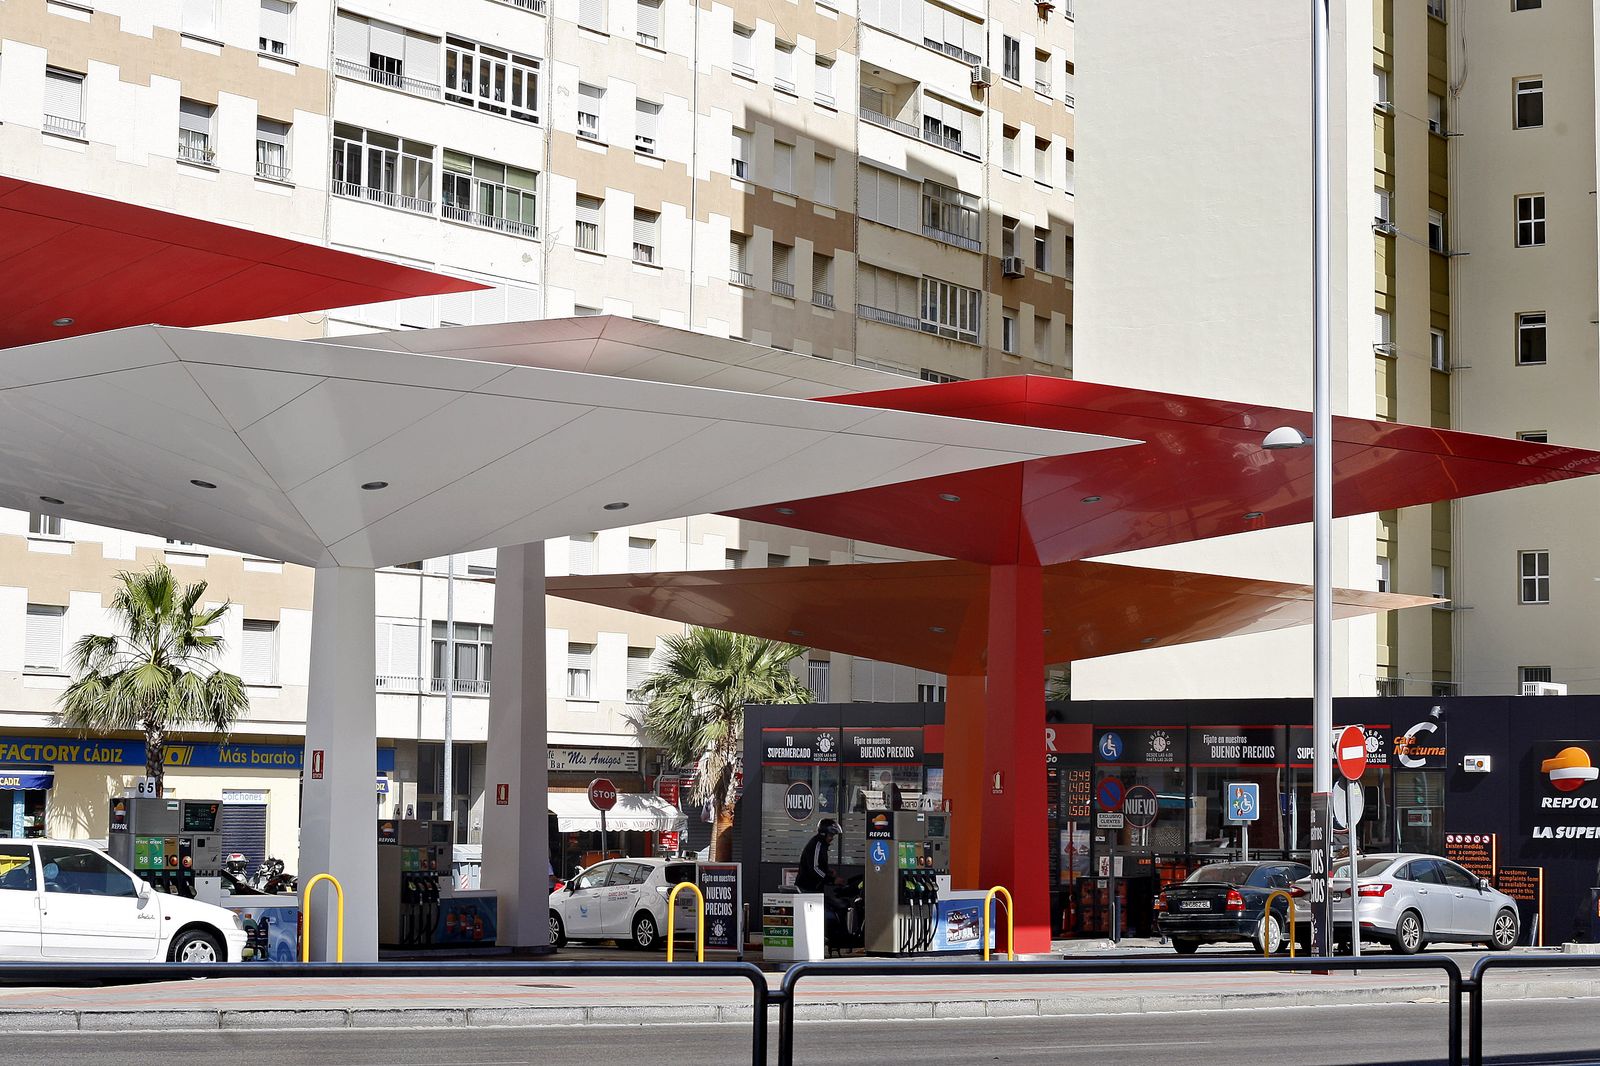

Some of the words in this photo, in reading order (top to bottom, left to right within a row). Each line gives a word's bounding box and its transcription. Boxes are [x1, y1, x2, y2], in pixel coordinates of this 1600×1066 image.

[786, 736, 793, 747] TU
[1218, 736, 1224, 744] en
[1226, 735, 1248, 744] nuestros
[0, 743, 80, 762] FACTORY
[83, 744, 123, 762] CÁDIZ
[219, 748, 247, 763] Más
[251, 750, 296, 764] barato
[767, 747, 811, 759] SUPERMERCADO
[860, 746, 885, 759] BUENOS
[886, 746, 915, 759] PRECIOS
[1211, 746, 1240, 758] BUENOS
[1242, 746, 1275, 758] PRECIOS
[1393, 745, 1446, 756] Nocturna
[550, 760, 566, 768] Bar
[1068, 770, 1090, 781] 1.349
[138, 783, 144, 794] 6
[147, 783, 154, 794] 5
[1068, 782, 1090, 792] 1.409
[222, 791, 262, 800] Colchones
[593, 790, 616, 800] STOP
[787, 794, 813, 810] NUEVO
[1126, 798, 1155, 816] NUEVO
[1541, 797, 1599, 808] REPSOL
[408, 808, 412, 816] 3
[1068, 805, 1090, 816] 1.560
[1532, 826, 1554, 839] LA
[719, 874, 736, 882] nuestros
[706, 886, 732, 900] NUEVOS
[706, 902, 732, 916] PRECIOS
